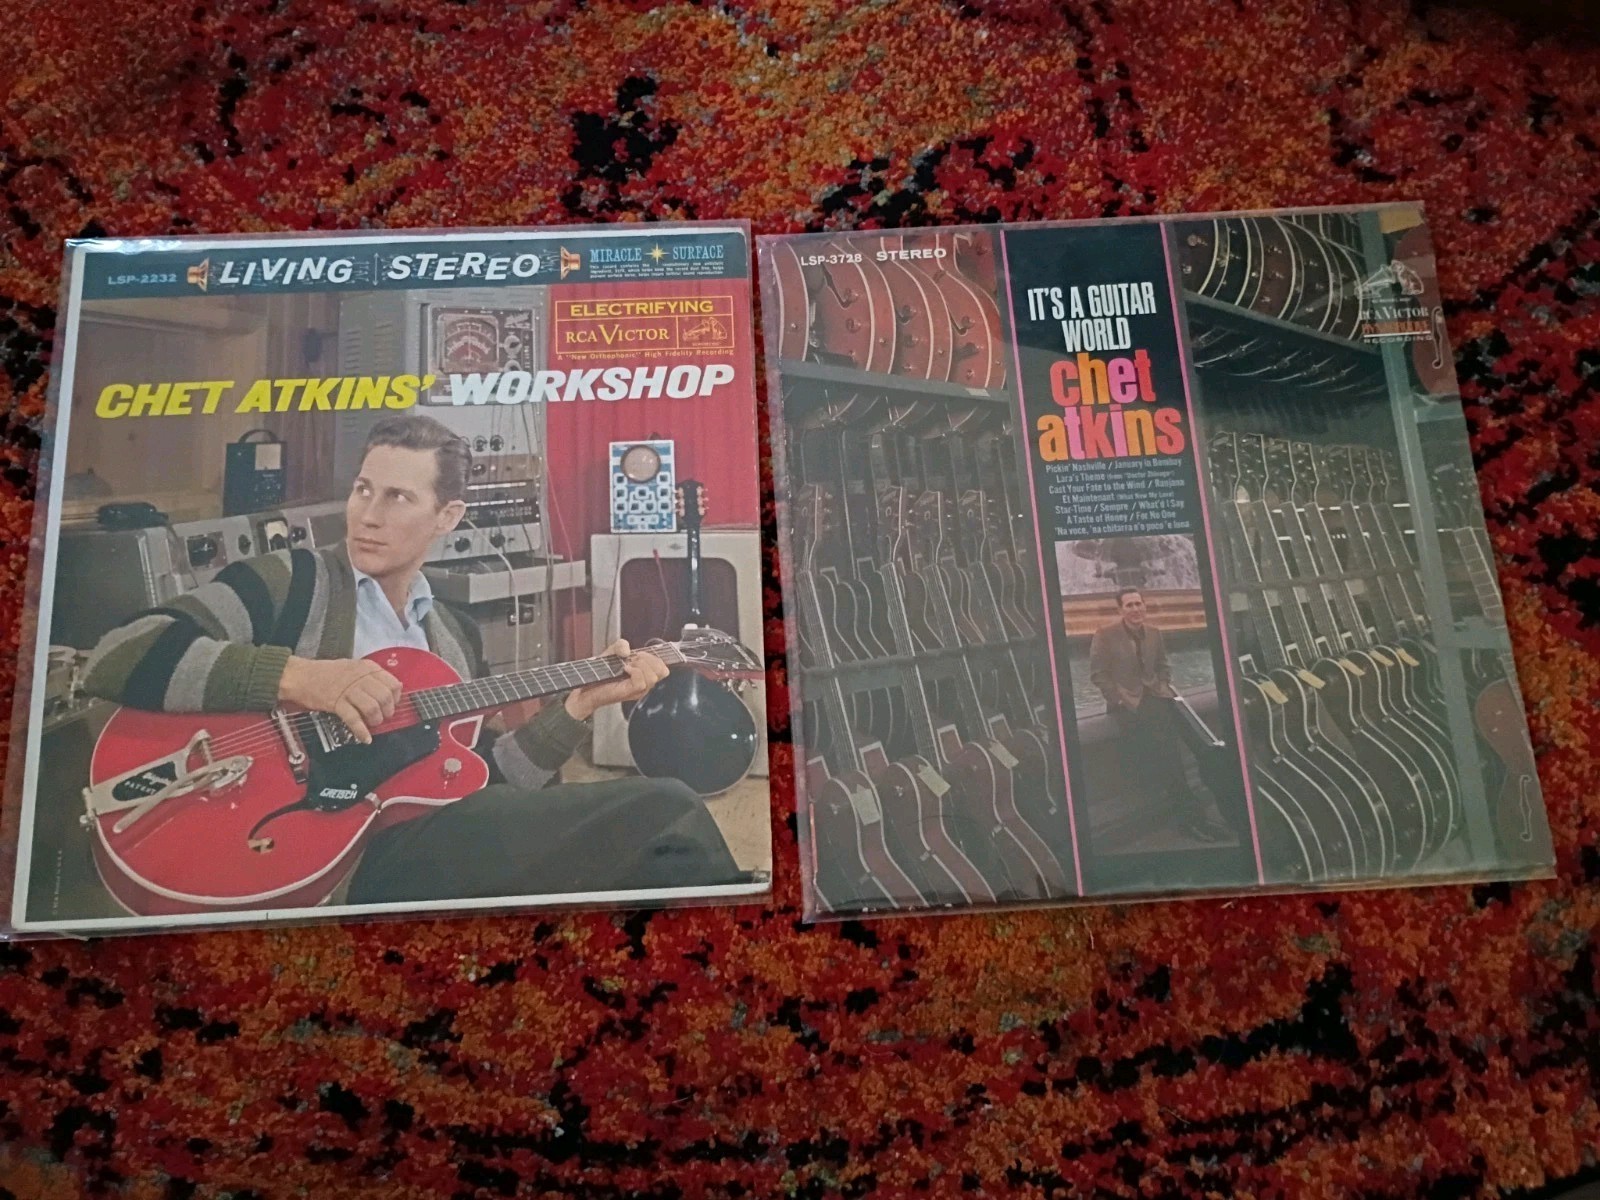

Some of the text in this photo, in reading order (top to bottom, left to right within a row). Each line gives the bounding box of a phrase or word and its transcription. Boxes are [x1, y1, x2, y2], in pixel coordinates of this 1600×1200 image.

[590, 245, 724, 263] MIRACLE SURFACE
[801, 248, 946, 266] LSP-3728 STEREO
[220, 252, 540, 285] LIVING STEREO
[108, 273, 176, 285] LSP-2232
[570, 300, 714, 316] ELECTRIFYING
[1028, 282, 1157, 320] IT'S A GUITAR
[566, 324, 670, 345] RCA VICTOR
[1062, 317, 1132, 352] WORLD
[644, 350, 662, 358] High
[1050, 348, 1156, 407] chet
[95, 364, 735, 418] CHET ATKINS' WORKSHOP
[1037, 404, 1184, 462] atkins
[1072, 462, 1106, 471] Nashville
[1056, 474, 1080, 483] Lara's
[1080, 472, 1105, 481] Theme
[1049, 485, 1066, 494] Cast
[1067, 484, 1084, 493] Your
[1086, 483, 1102, 492] Fate
[1104, 482, 1112, 490] to
[1113, 482, 1125, 490] the
[1126, 480, 1146, 489] Wind
[1100, 503, 1128, 512] Sempre
[1067, 516, 1072, 524] A
[1072, 514, 1094, 524] Taste
[1104, 513, 1128, 522] Honey
[1136, 512, 1148, 520] For
[1150, 510, 1160, 519] No
